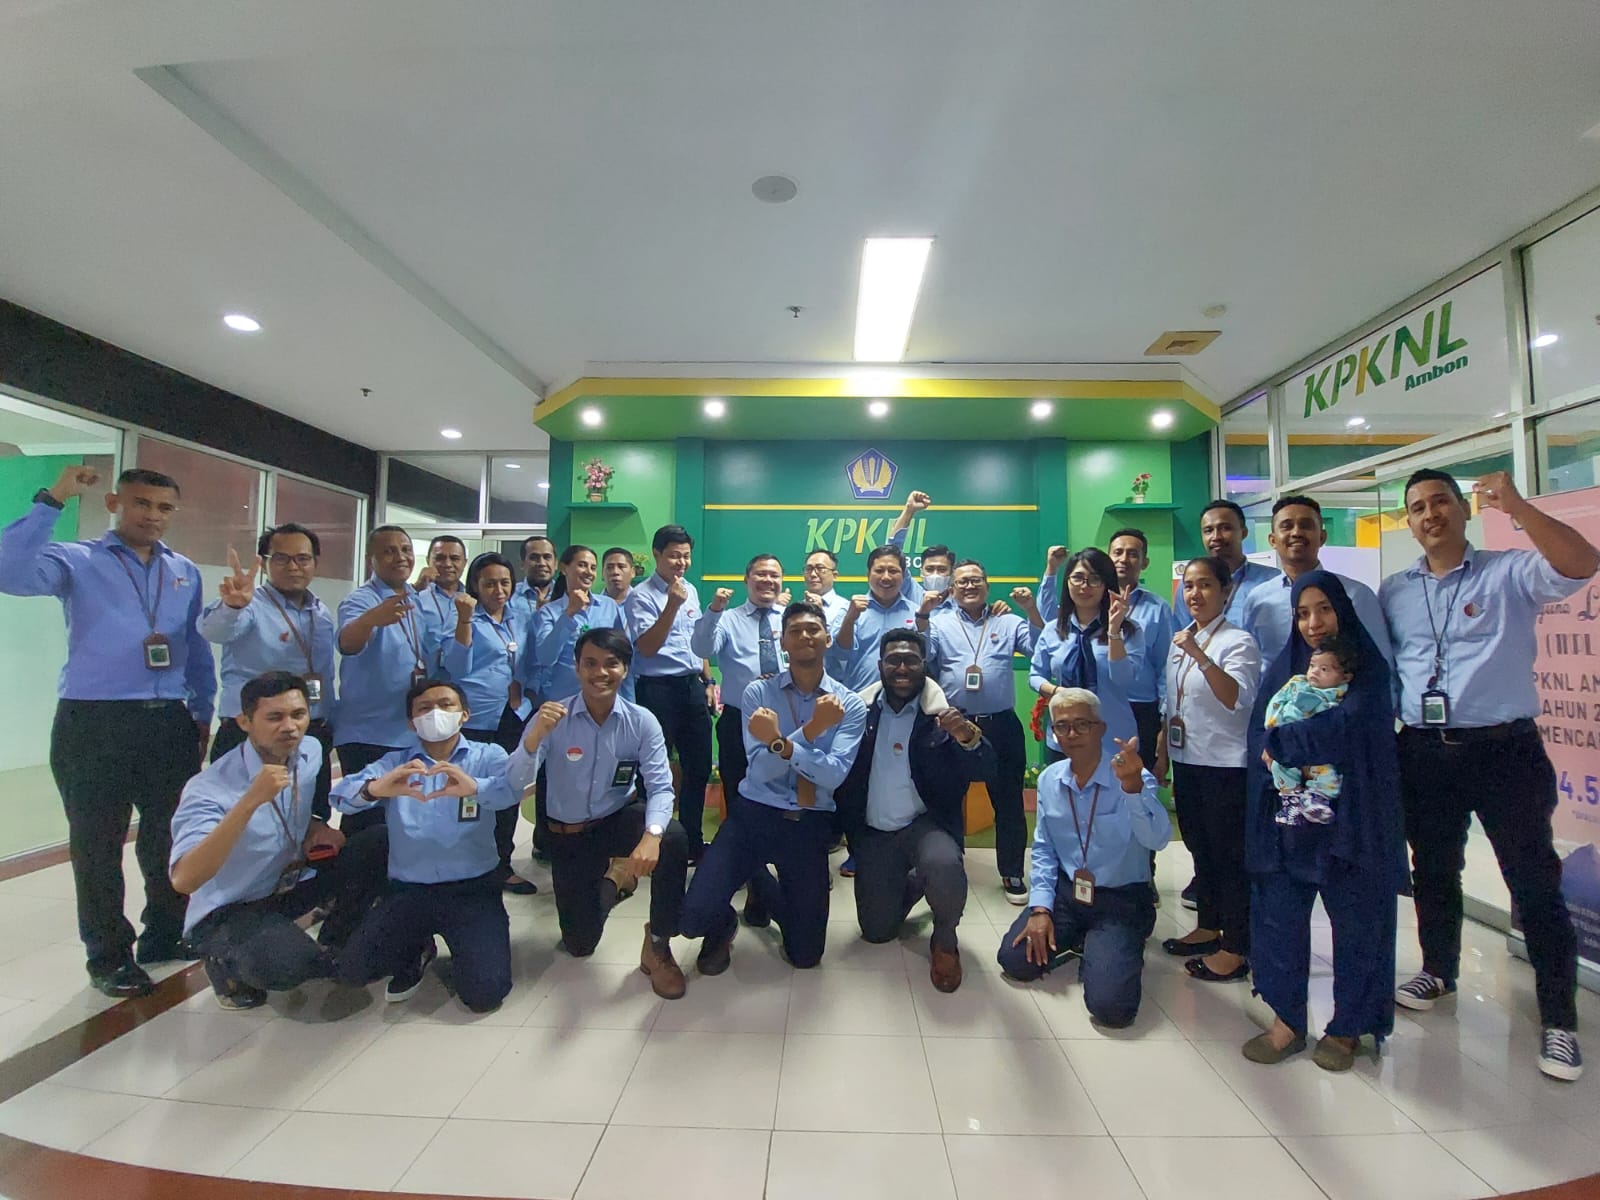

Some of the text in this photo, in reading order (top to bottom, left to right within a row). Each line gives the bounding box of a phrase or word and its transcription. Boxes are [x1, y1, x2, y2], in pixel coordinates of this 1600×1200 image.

[1304, 301, 1468, 418] KPKNL
[1405, 356, 1468, 391] Ambon
[1542, 699, 1587, 720] AHUN
